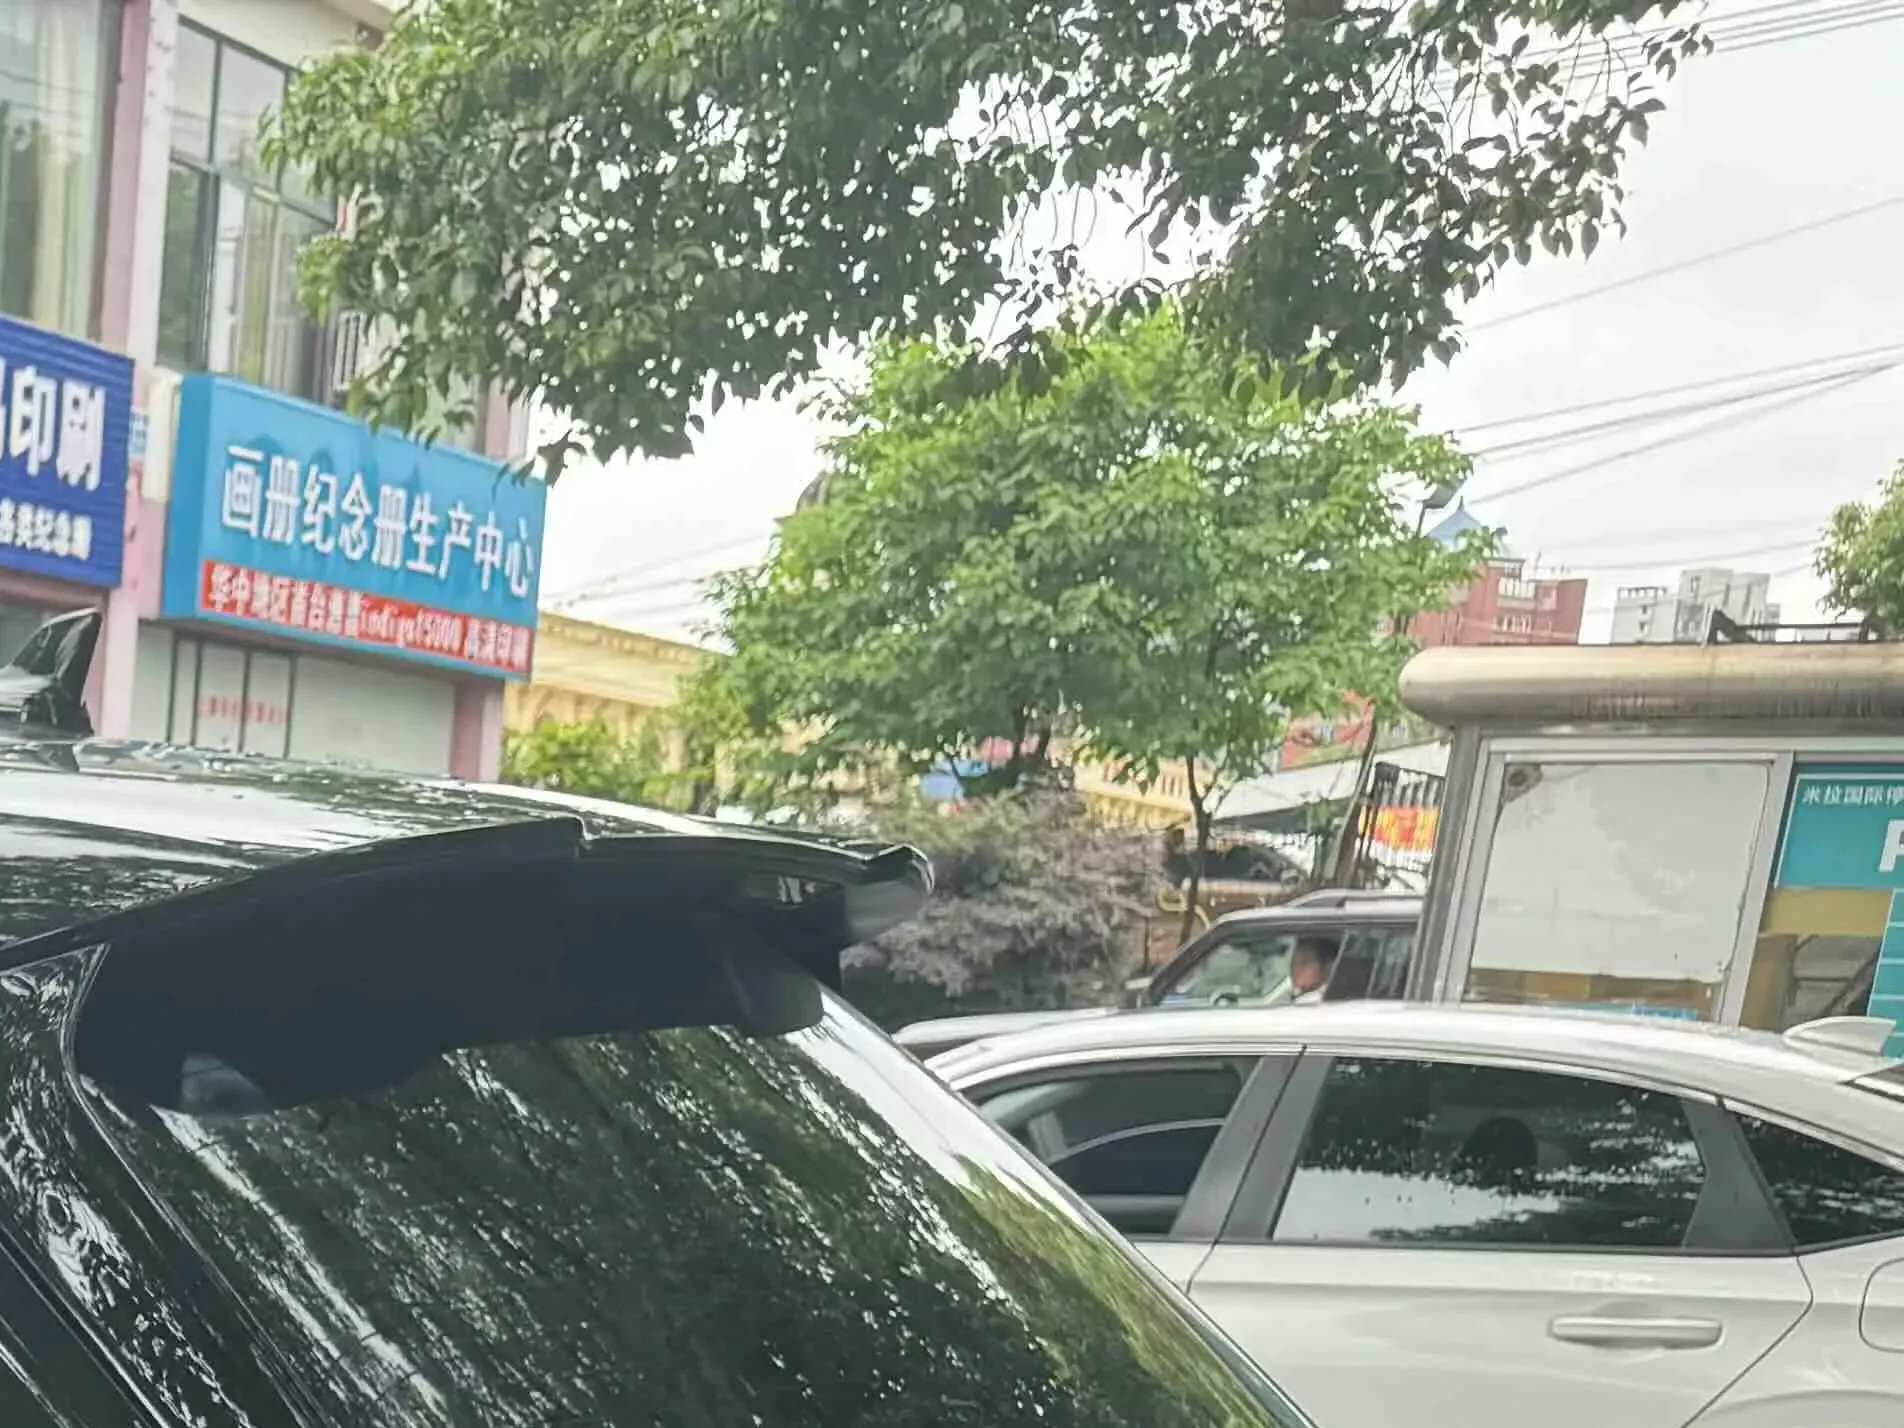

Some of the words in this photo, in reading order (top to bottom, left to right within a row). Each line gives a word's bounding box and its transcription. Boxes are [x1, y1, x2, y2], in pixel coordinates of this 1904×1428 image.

[222, 445, 536, 598] 画册纪念册生产中心
